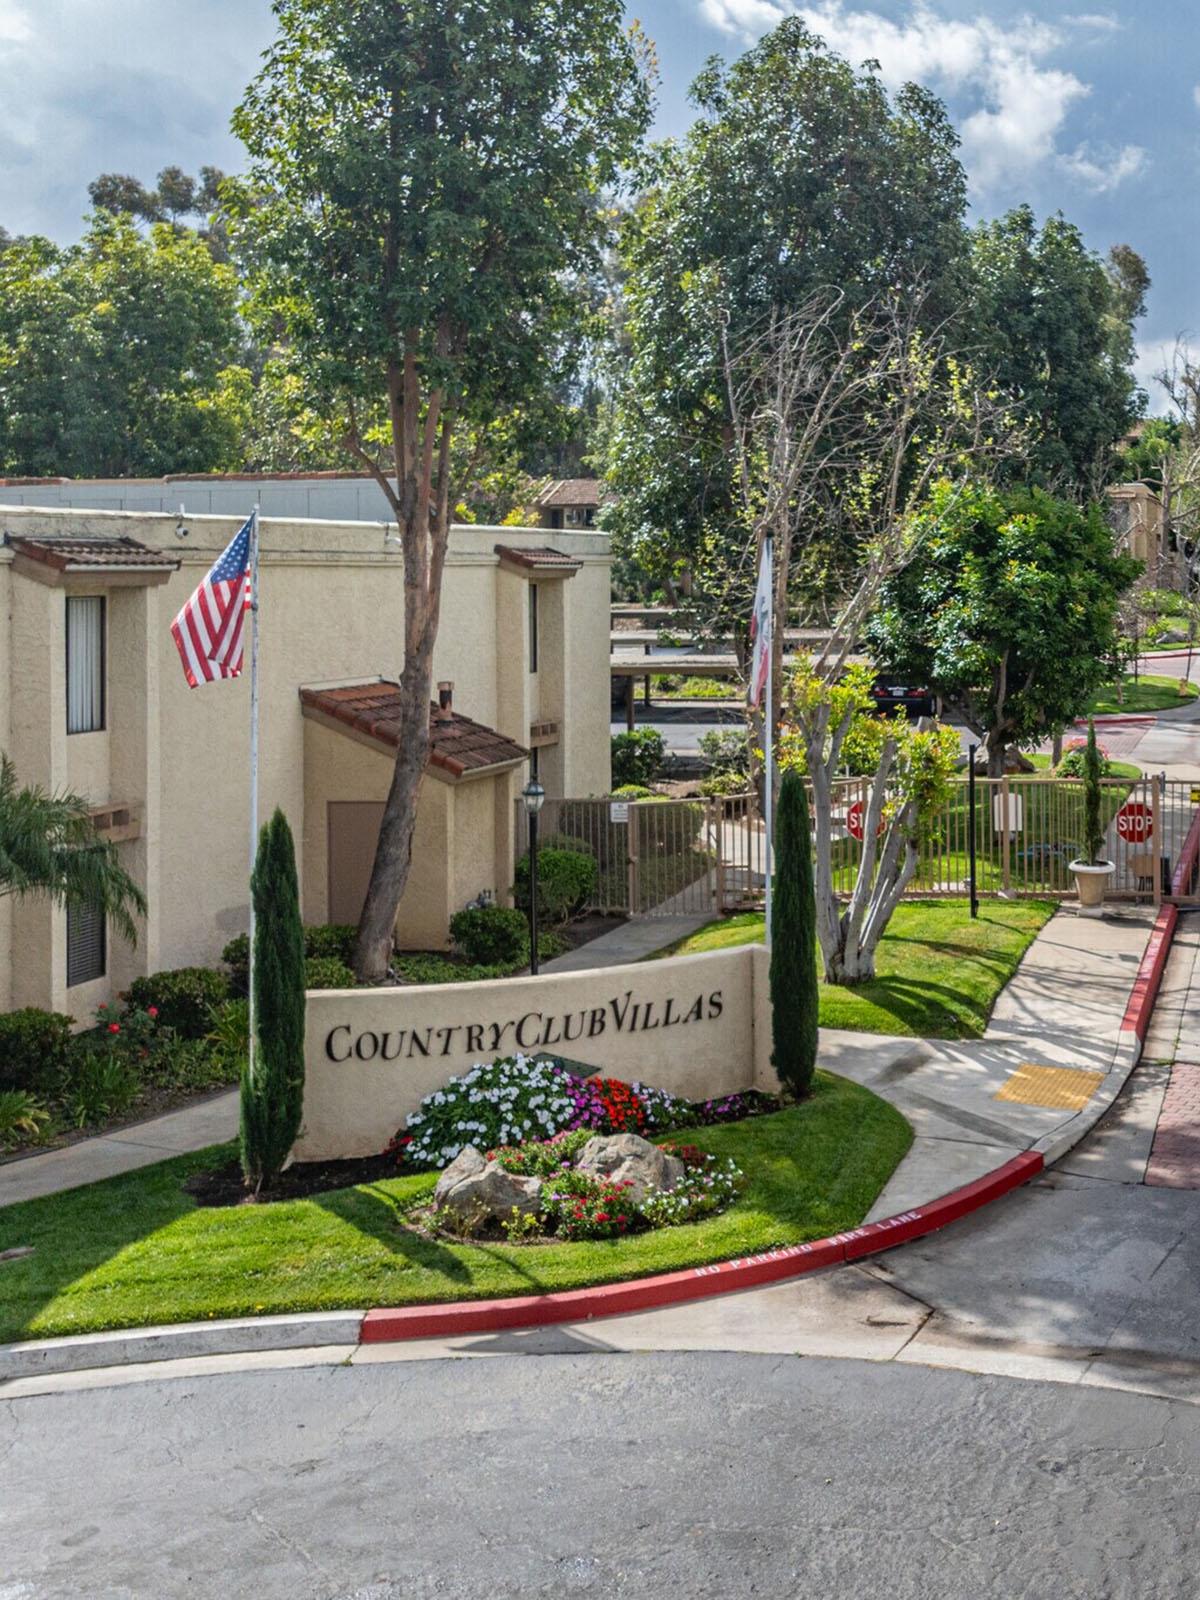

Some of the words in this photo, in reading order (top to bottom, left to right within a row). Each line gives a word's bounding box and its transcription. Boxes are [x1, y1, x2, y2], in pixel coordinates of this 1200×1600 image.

[1119, 815, 1153, 831] STOP
[324, 1020, 515, 1062] COUNTRY
[515, 1007, 606, 1049] CLUB
[609, 990, 723, 1033] VILLAS
[694, 1264, 720, 1277] NO
[729, 1243, 813, 1269] PARKING
[827, 1228, 870, 1246] FIRE
[876, 1211, 922, 1230] LANE
